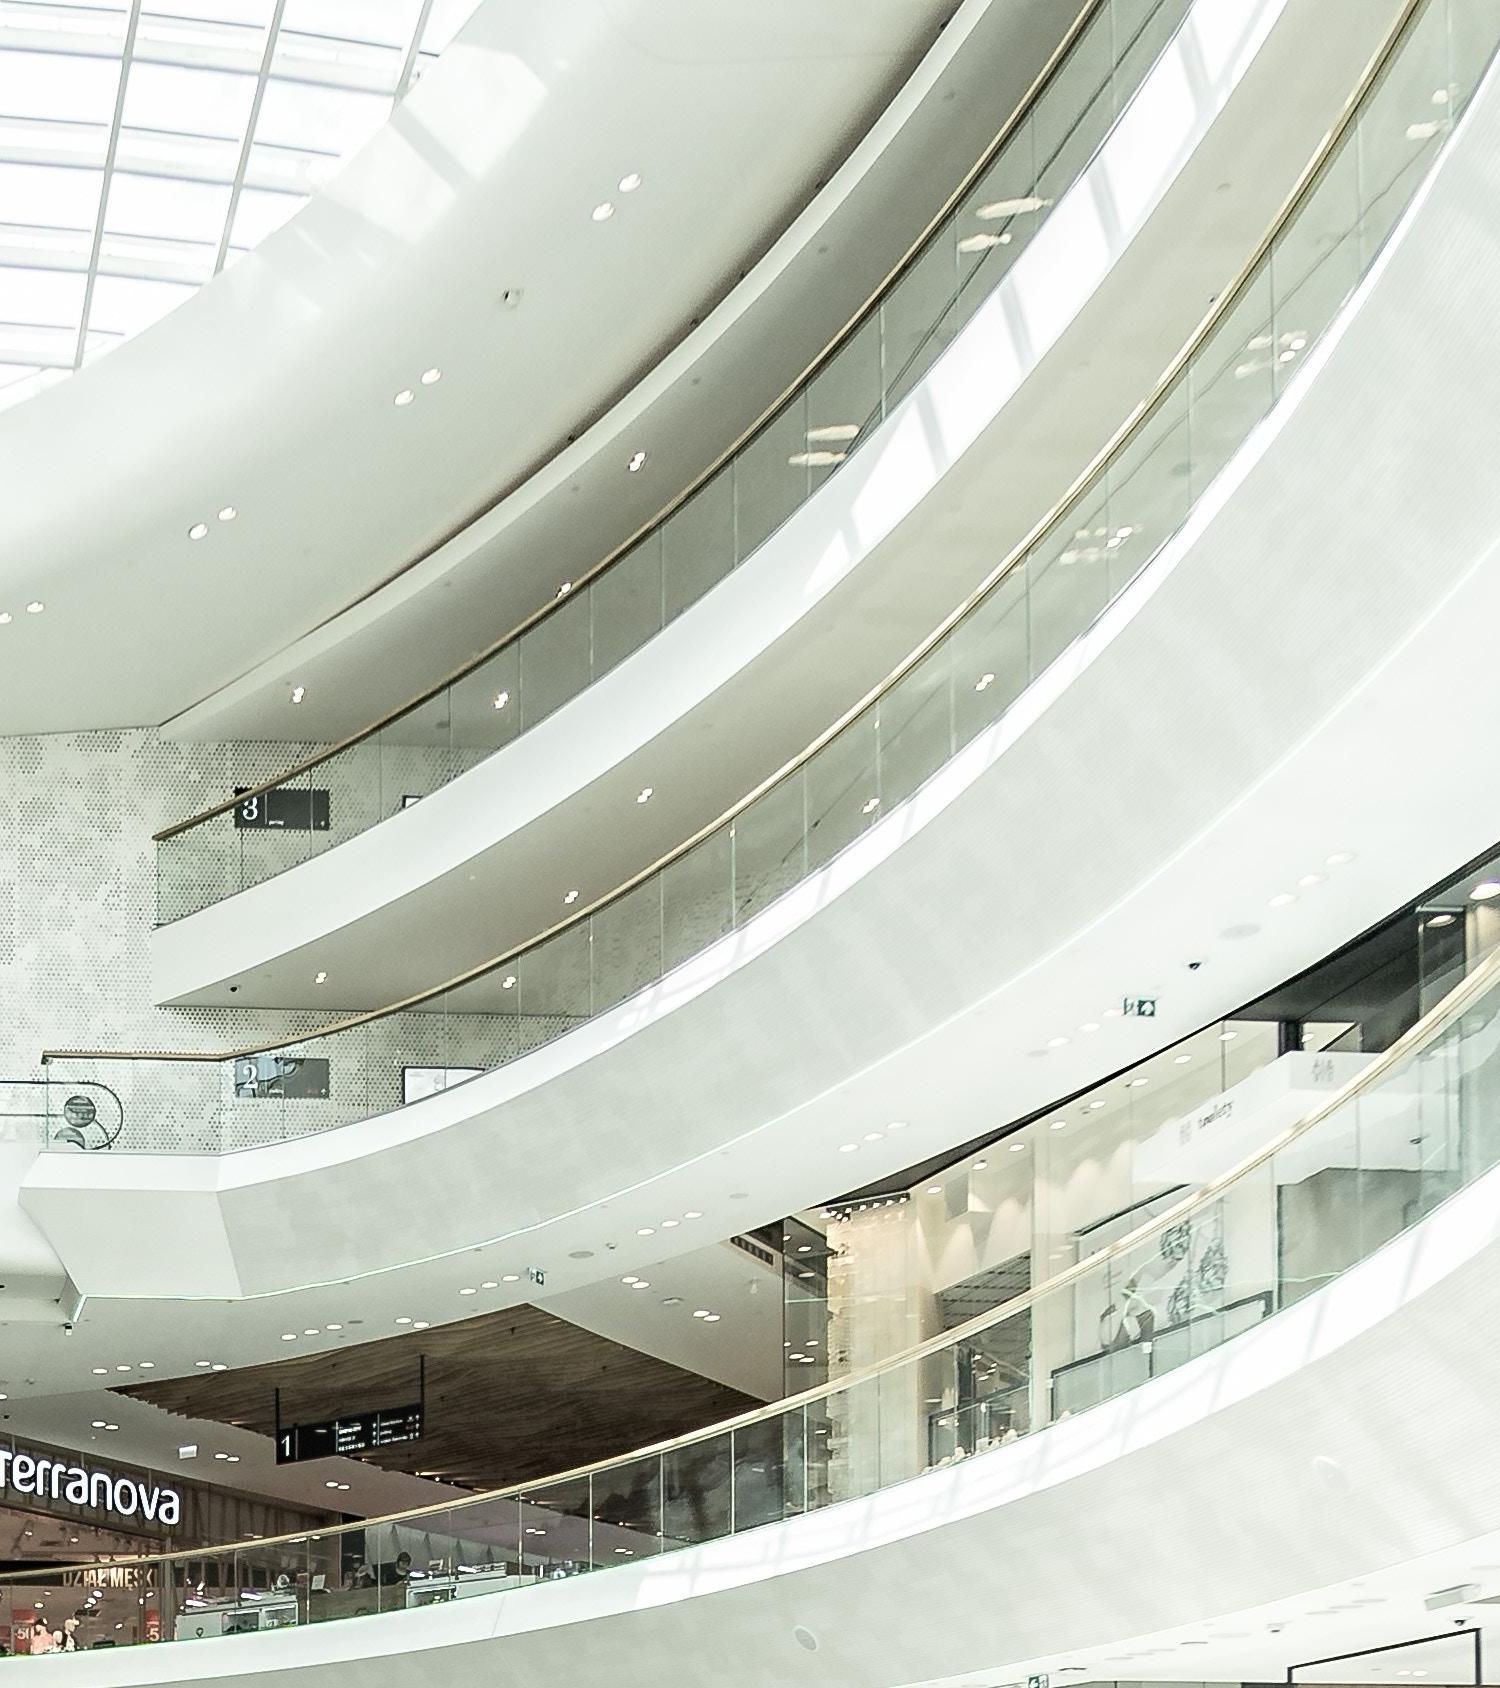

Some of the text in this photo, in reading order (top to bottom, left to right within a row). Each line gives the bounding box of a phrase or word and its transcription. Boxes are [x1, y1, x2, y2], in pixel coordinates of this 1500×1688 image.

[242, 796, 259, 820] 3
[242, 1064, 259, 1089] 2
[281, 1434, 291, 1457] 1
